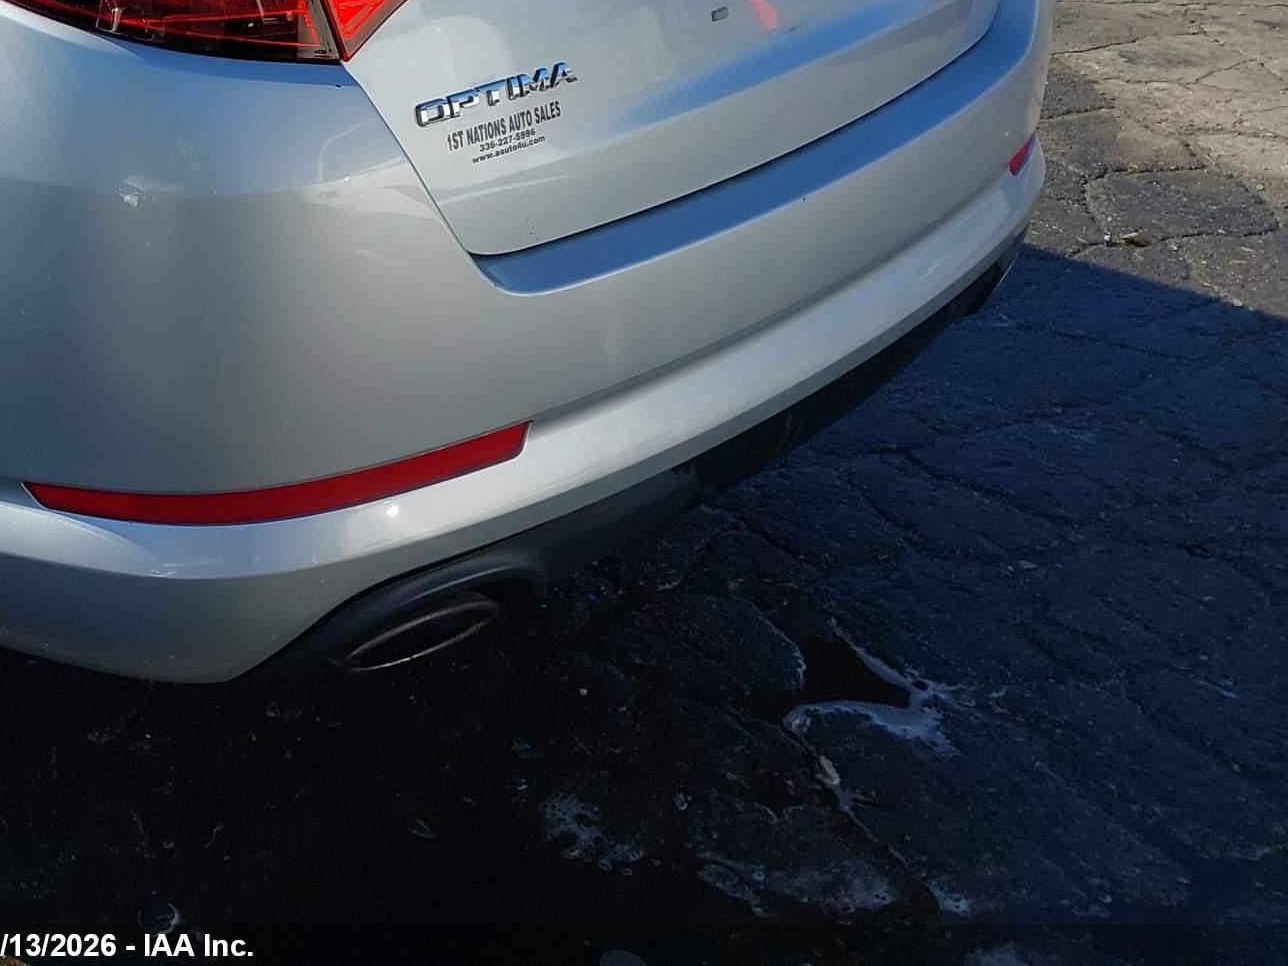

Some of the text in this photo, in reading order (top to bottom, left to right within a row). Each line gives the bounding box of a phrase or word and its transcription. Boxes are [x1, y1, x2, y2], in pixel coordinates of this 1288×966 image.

[414, 61, 579, 128] OPTIMA
[447, 100, 562, 152] 1ST NATIONS AUTO SALES
